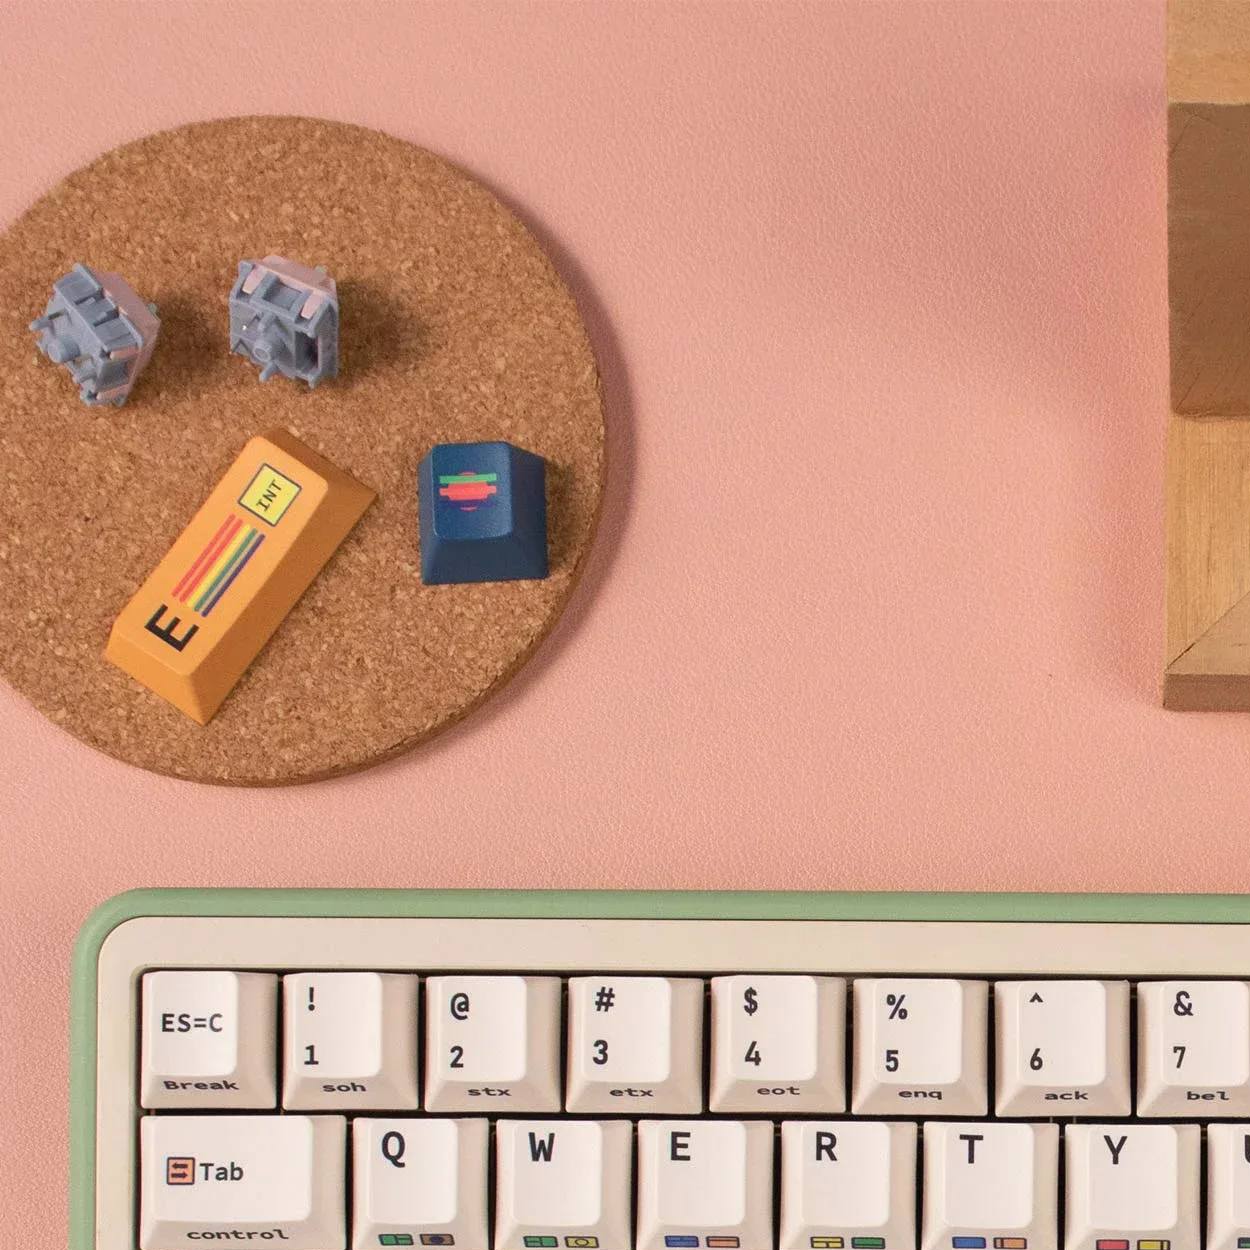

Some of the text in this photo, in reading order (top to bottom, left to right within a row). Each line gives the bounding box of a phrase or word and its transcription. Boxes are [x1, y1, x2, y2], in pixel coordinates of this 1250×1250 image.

[256, 479, 282, 511] INT
[144, 605, 199, 652] E
[307, 986, 316, 1012] !
[450, 992, 470, 1021] @
[594, 986, 616, 1013] #
[743, 986, 759, 1017] $
[886, 993, 908, 1020] %
[1173, 990, 1194, 1017] &
[161, 1012, 223, 1033] ES=C
[303, 1044, 320, 1066] 1
[449, 1045, 464, 1069] 2
[592, 1039, 609, 1066] 3
[744, 1040, 762, 1067] 4
[885, 1049, 899, 1073] 5
[1029, 1047, 1044, 1071] 6
[1172, 1045, 1187, 1069] 7
[162, 1079, 240, 1091] Break
[322, 1081, 367, 1093] soh
[467, 1087, 512, 1097] stx
[609, 1087, 654, 1097] etx
[756, 1086, 801, 1096] eot
[898, 1090, 943, 1101] enq
[1044, 1090, 1089, 1101] ack
[1186, 1090, 1230, 1101] bel
[381, 1130, 406, 1169] Q
[528, 1131, 556, 1163] W
[670, 1130, 691, 1162] E
[815, 1131, 838, 1162] R
[958, 1133, 984, 1165] T
[1103, 1134, 1128, 1165] Y
[199, 1161, 244, 1182] Tab
[186, 1228, 289, 1240] control
